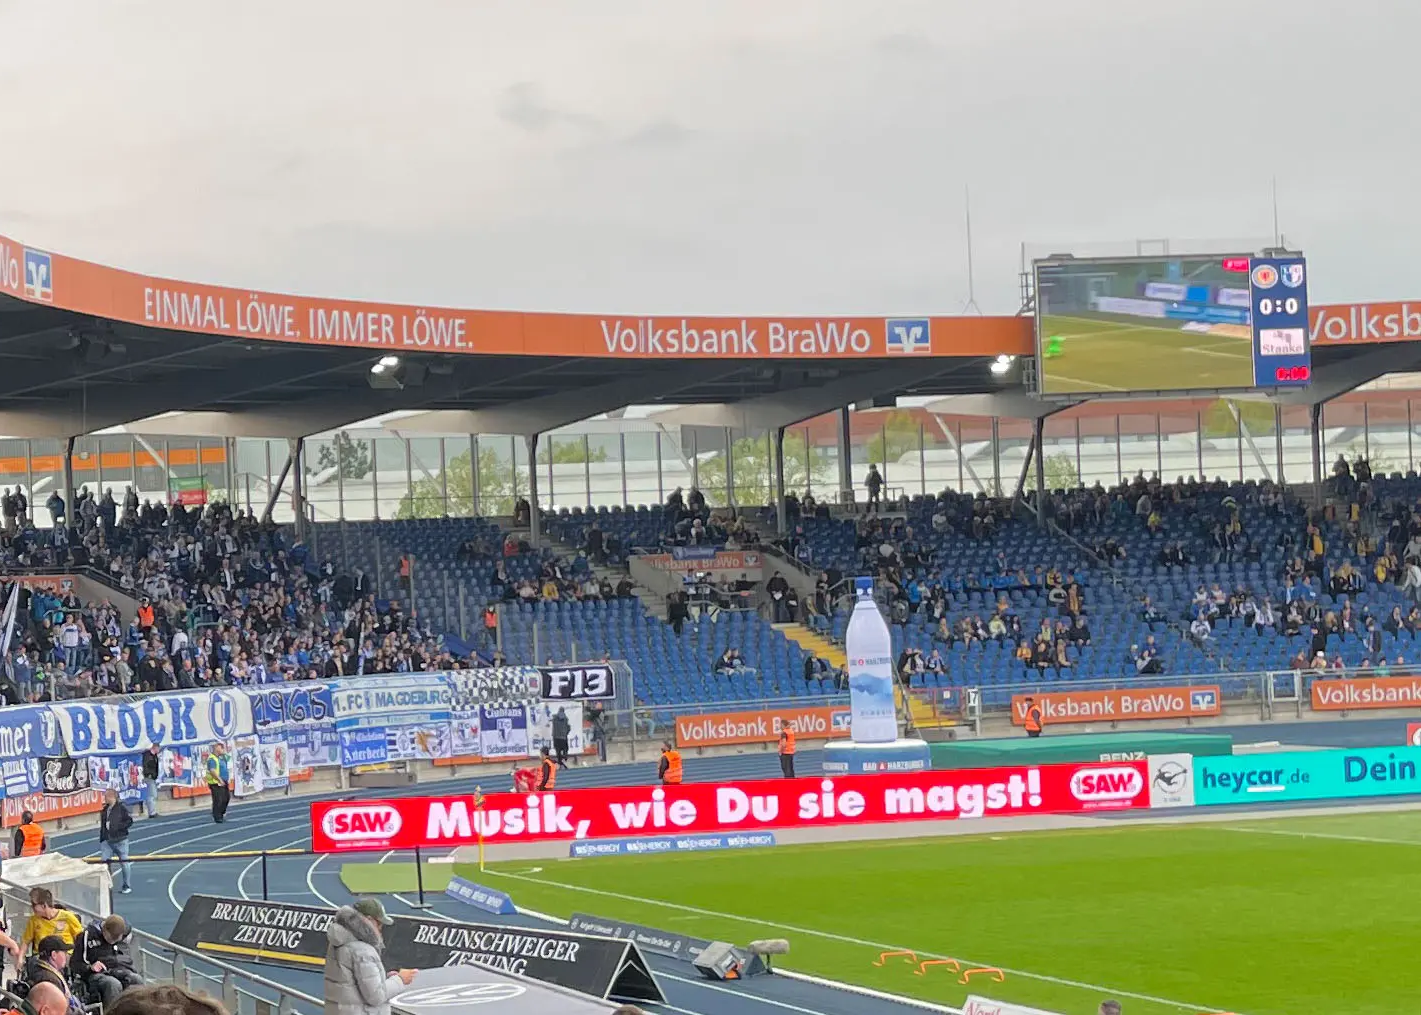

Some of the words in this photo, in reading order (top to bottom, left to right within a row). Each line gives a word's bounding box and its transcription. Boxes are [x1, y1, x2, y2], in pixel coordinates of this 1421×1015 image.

[144, 287, 230, 330] EINMAL
[309, 308, 395, 344] IMMER
[402, 309, 473, 349] LÖWE.
[600, 319, 759, 354] Volksbank
[768, 322, 871, 354] BraWo
[375, 688, 451, 708] MAGDEBURG
[548, 668, 608, 698] F13
[253, 687, 326, 727] 1965
[1016, 697, 1115, 718] Vlksbank
[1121, 695, 1184, 713] BraWo
[65, 697, 198, 752] BLOCK
[680, 716, 767, 742] Volksbank
[773, 714, 827, 734] BaWo
[1202, 766, 1311, 793] heycar.de
[1343, 752, 1416, 784] Dein
[335, 811, 392, 834] SAW
[425, 794, 592, 839] Musik,
[609, 788, 698, 829] wie
[716, 786, 780, 824] Du
[798, 779, 866, 819] sie
[884, 768, 1042, 820] magst!
[1081, 772, 1134, 794] SAW
[210, 901, 336, 932] BRAUNSCHWEIGE
[233, 924, 302, 950] ZEITUNG
[413, 924, 580, 962] BRAUNSCHWEIGER
[444, 950, 528, 977] ZEITUNG
